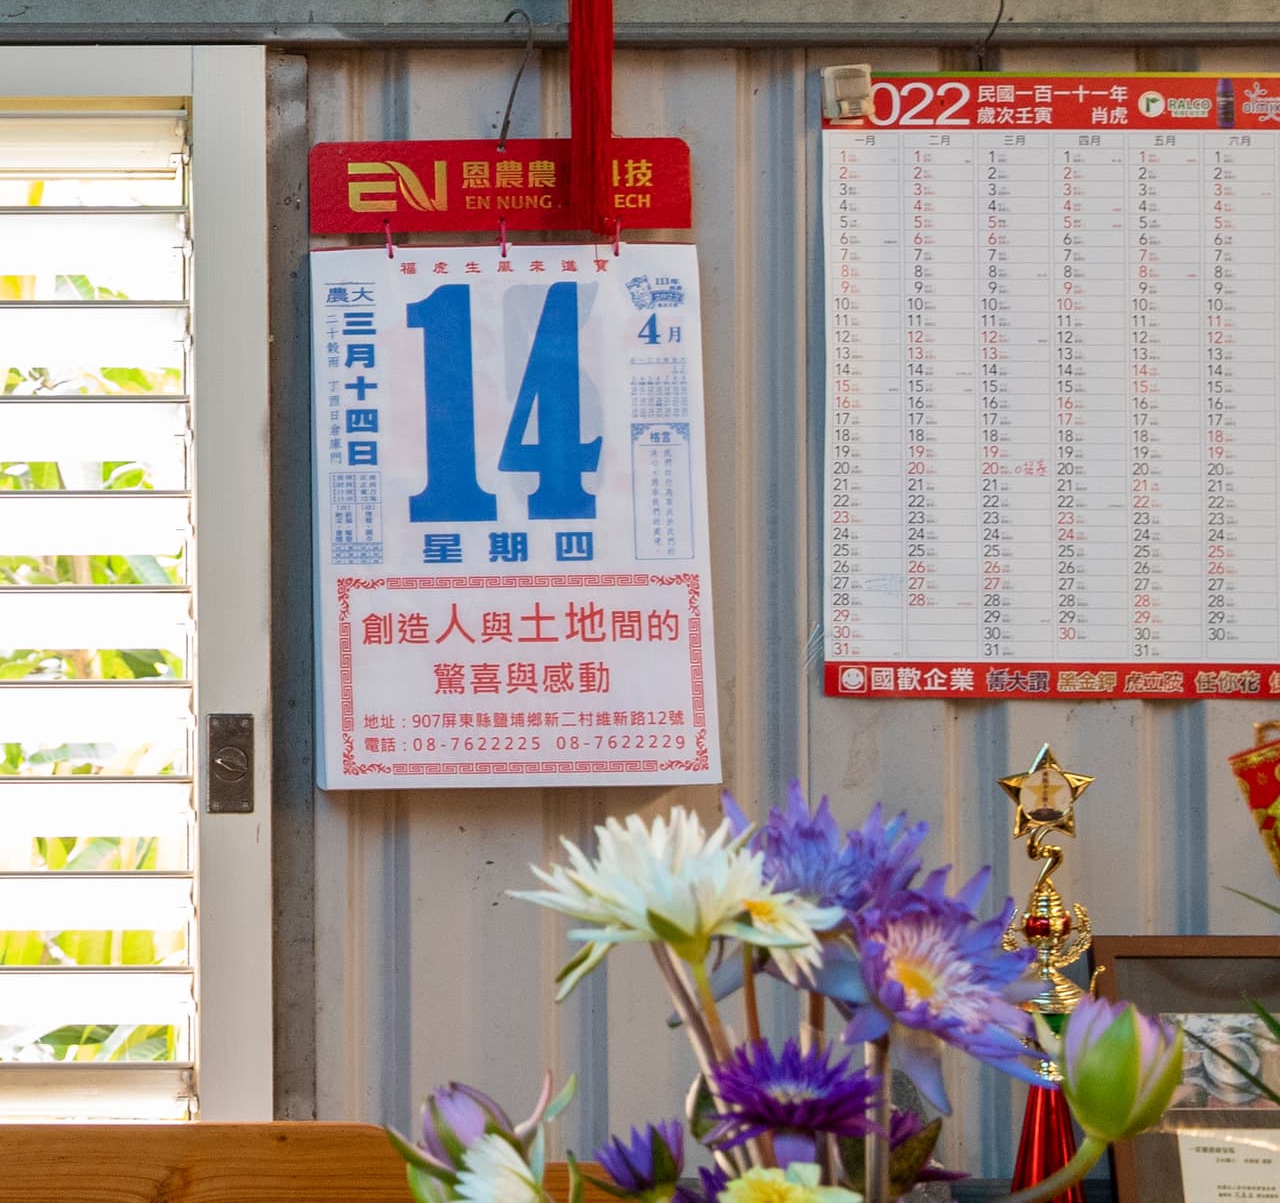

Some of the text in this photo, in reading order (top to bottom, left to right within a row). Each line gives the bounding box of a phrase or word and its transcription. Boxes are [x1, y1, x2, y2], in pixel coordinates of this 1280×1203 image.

[976, 84, 1129, 104] 民國一百一十一年
[830, 82, 972, 126] 022
[1167, 98, 1212, 110] RALCO
[976, 106, 1129, 126] 歲次壬寅 肖虎
[854, 135, 876, 146] 一月
[928, 135, 951, 146] 二月
[1003, 135, 1026, 146] 三月
[1078, 135, 1101, 146] 四月
[1153, 135, 1176, 146] 五月
[1228, 135, 1251, 146] 六月
[841, 151, 845, 161] 1
[1064, 151, 1069, 162] 1
[1216, 151, 1220, 162] 1
[840, 167, 847, 179] 2
[1064, 167, 1071, 179] 2
[1214, 167, 1222, 180] 2
[840, 183, 847, 195] 3
[1064, 183, 1071, 196] 3
[1215, 184, 1222, 196] 3
[465, 195, 553, 210] EN NUNG
[840, 200, 848, 211] 4
[1064, 200, 1071, 211] 4
[1214, 200, 1222, 211] 4
[841, 216, 847, 228] 5
[1064, 216, 1071, 228] 5
[1215, 217, 1222, 229] 5
[840, 233, 848, 244] 6
[1064, 233, 1072, 245] 6
[1214, 234, 1222, 245] 6
[841, 249, 848, 260] 7
[1064, 249, 1071, 261] 7
[1215, 249, 1222, 261] 7
[842, 265, 848, 277] 8
[1064, 265, 1072, 278] 8
[1215, 266, 1222, 278] 8
[842, 281, 849, 293] 9
[1064, 282, 1072, 294] 9
[1215, 282, 1223, 294] 9
[835, 298, 849, 310] 10
[1057, 298, 1072, 310] 10
[1208, 299, 1222, 311] 10
[835, 314, 847, 326] 11
[1058, 315, 1070, 326] 11
[1208, 316, 1221, 327] 11
[836, 331, 850, 343] 12
[1057, 331, 1072, 343] 12
[1208, 332, 1222, 344] 12
[837, 347, 850, 359] 13
[1058, 347, 1072, 360] 13
[1208, 348, 1222, 360] 13
[836, 364, 850, 375] 14
[1058, 364, 1072, 375] 14
[1208, 365, 1222, 376] 14
[341, 311, 381, 468] 三月十四日
[836, 380, 849, 392] 15
[1058, 380, 1072, 392] 15
[1208, 381, 1222, 393] 15
[406, 281, 603, 523] 14
[836, 397, 850, 408] 16
[1059, 397, 1073, 409] 16
[1208, 398, 1223, 410] 16
[835, 413, 850, 424] 17
[1058, 413, 1072, 425] 17
[1208, 414, 1222, 425] 17
[835, 429, 849, 441] 18
[1059, 430, 1073, 442] 18
[1208, 430, 1223, 442] 18
[835, 445, 850, 457] 19
[1059, 446, 1073, 458] 19
[1209, 447, 1223, 458] 19
[834, 462, 849, 474] 20
[1057, 462, 1073, 475] 20
[1208, 463, 1224, 475] 20
[833, 478, 847, 490] 21
[1057, 479, 1071, 491] 21
[1208, 479, 1222, 492] 21
[833, 494, 849, 507] 22
[1058, 495, 1073, 508] 22
[833, 511, 849, 523] 23
[1058, 512, 1074, 524] 23
[833, 527, 849, 540] 24
[1058, 528, 1074, 540] 24
[422, 530, 596, 565] 星期四
[833, 544, 849, 556] 25
[1058, 545, 1074, 557] 25
[833, 560, 849, 573] 26
[1058, 561, 1075, 574] 26
[833, 577, 849, 589] 27
[1058, 578, 1074, 590] 27
[833, 593, 849, 605] 28
[1059, 594, 1075, 607] 28
[833, 609, 849, 622] 29
[1059, 611, 1075, 623] 29
[361, 601, 680, 647] 創造人與土地間的
[833, 626, 850, 638] 30
[1060, 627, 1075, 640] 30
[834, 642, 848, 655] 31
[433, 661, 612, 697] 驚喜與感動
[870, 667, 974, 692] 國歡企業
[555, 734, 687, 751] 08-7622229
